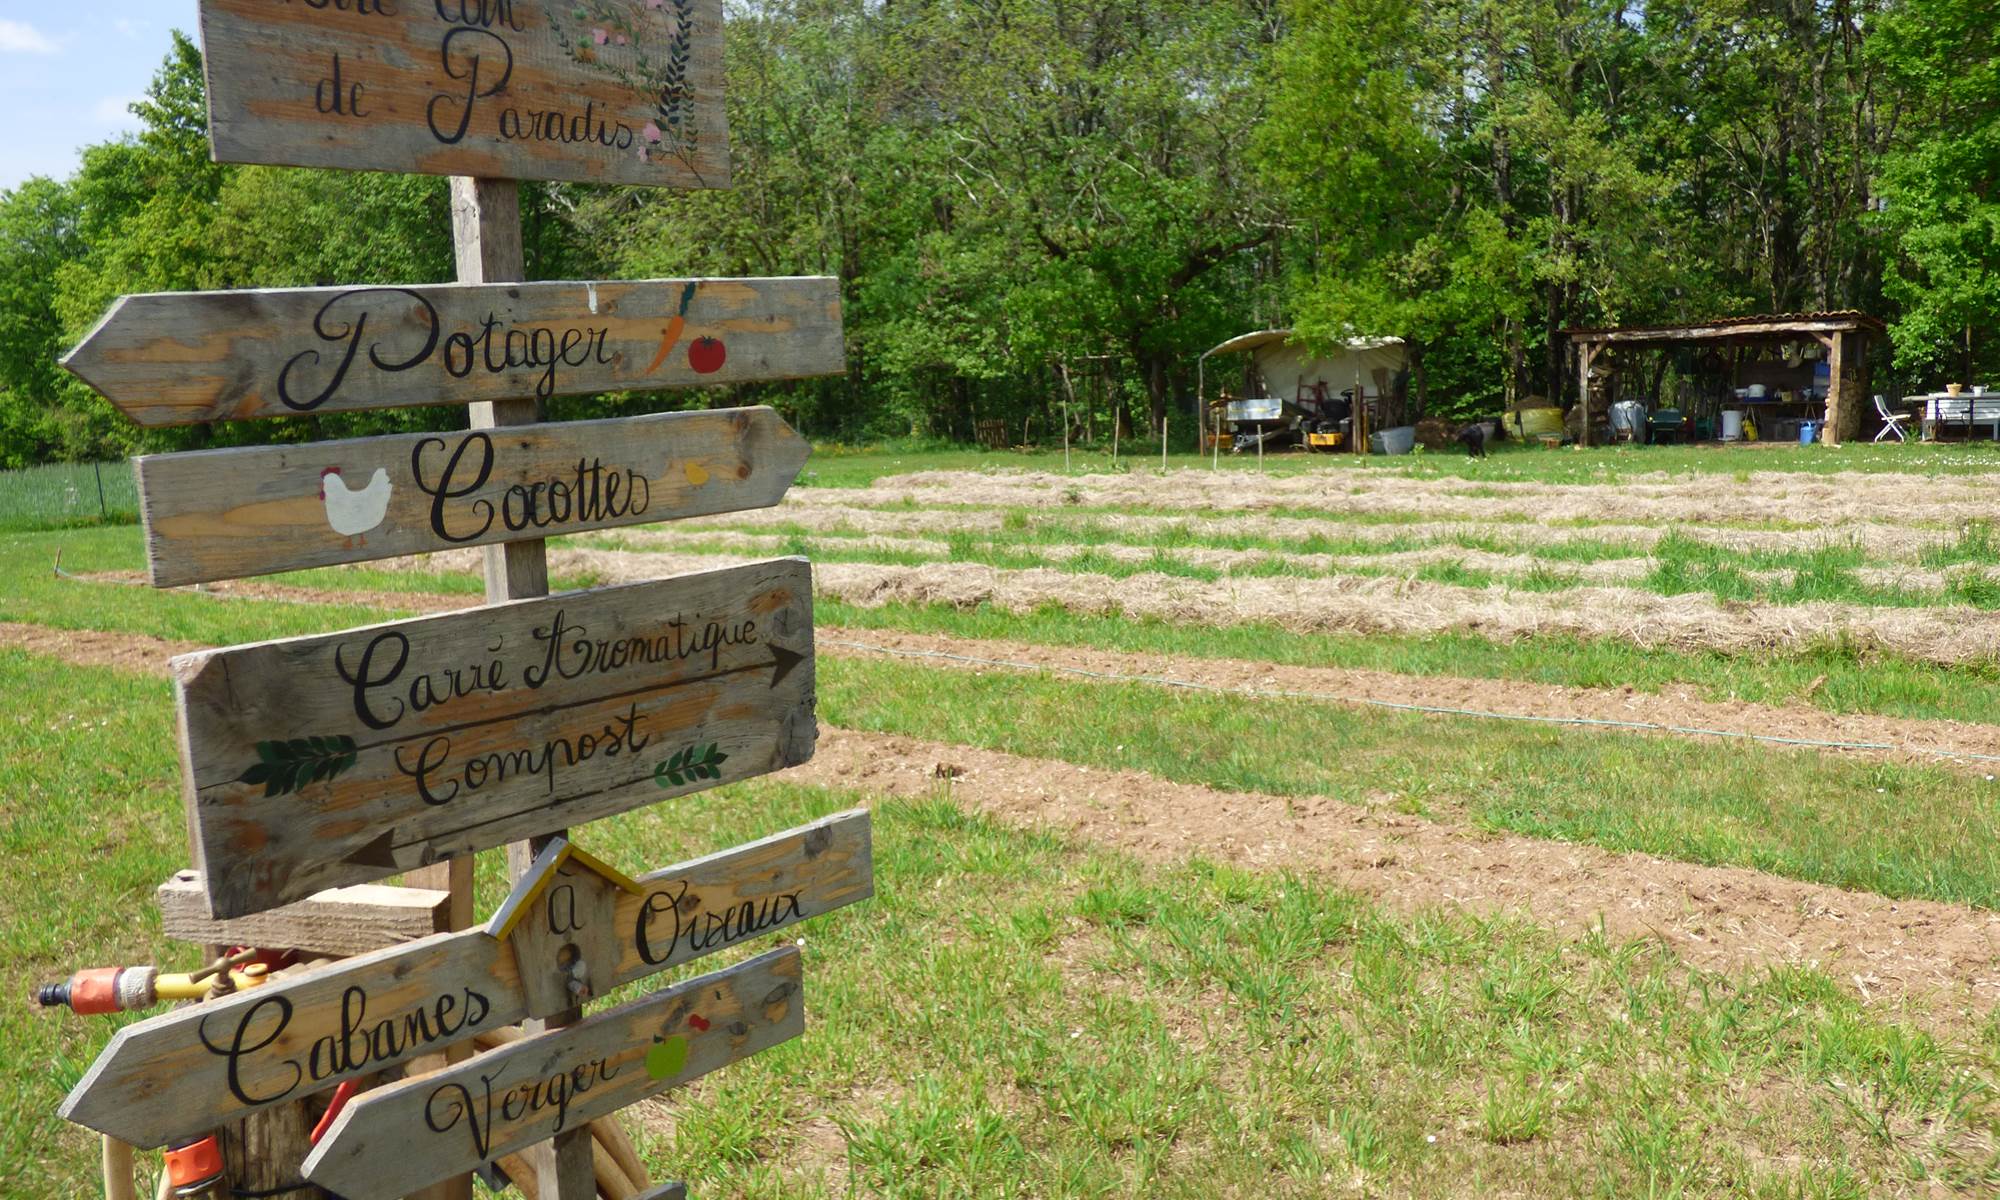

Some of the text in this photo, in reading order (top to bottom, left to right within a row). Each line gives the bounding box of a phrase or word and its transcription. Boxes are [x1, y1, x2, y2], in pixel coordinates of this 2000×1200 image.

[316, 27, 633, 150] de Paradis
[277, 288, 613, 411] Potager
[411, 432, 650, 543] Cocottes
[335, 609, 758, 730] Carré Aromatique
[394, 702, 651, 806] Compost
[199, 867, 810, 1106] Cabanes à Oiseaux
[424, 1057, 621, 1161] Verger
